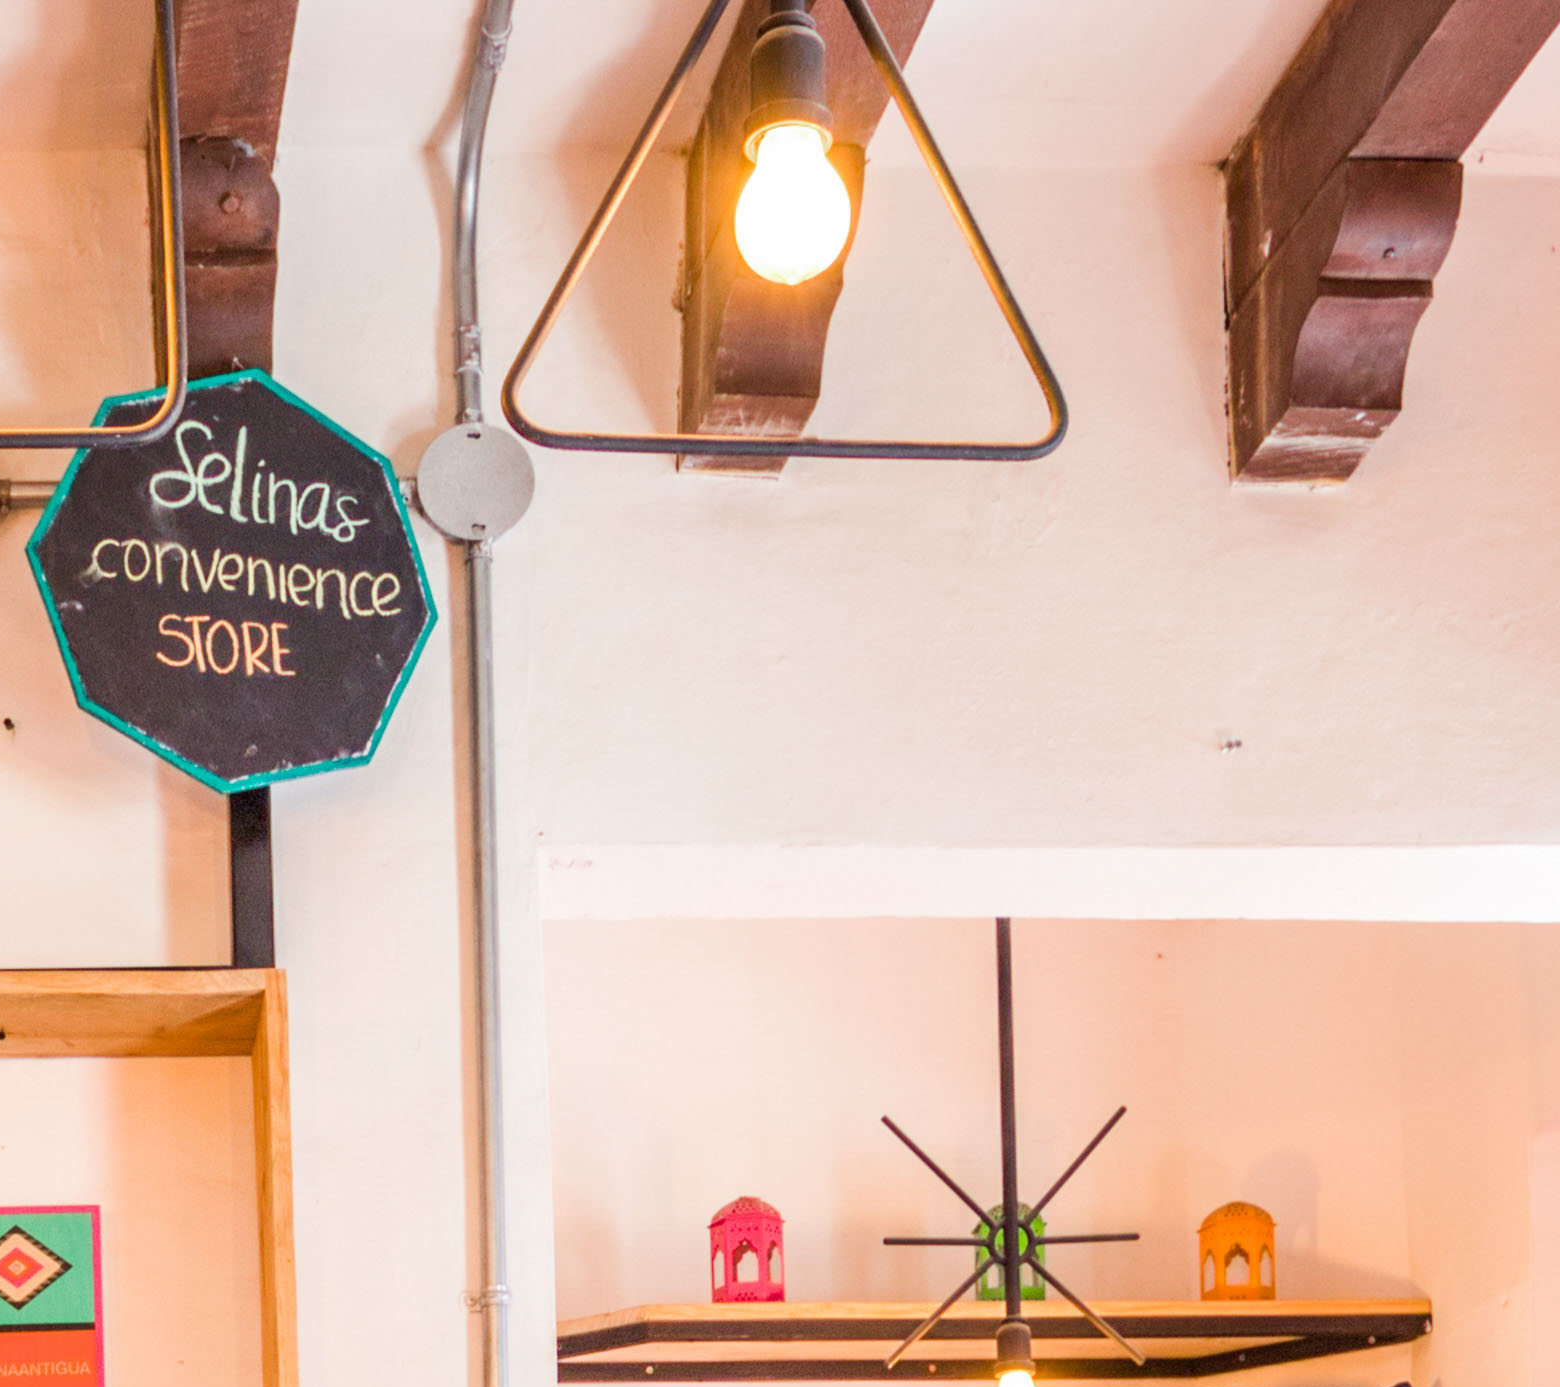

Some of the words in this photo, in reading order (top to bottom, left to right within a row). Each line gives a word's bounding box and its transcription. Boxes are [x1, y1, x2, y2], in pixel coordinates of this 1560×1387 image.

[149, 420, 370, 543] Selinas
[90, 537, 401, 620] convenience
[156, 613, 296, 677] STORE
